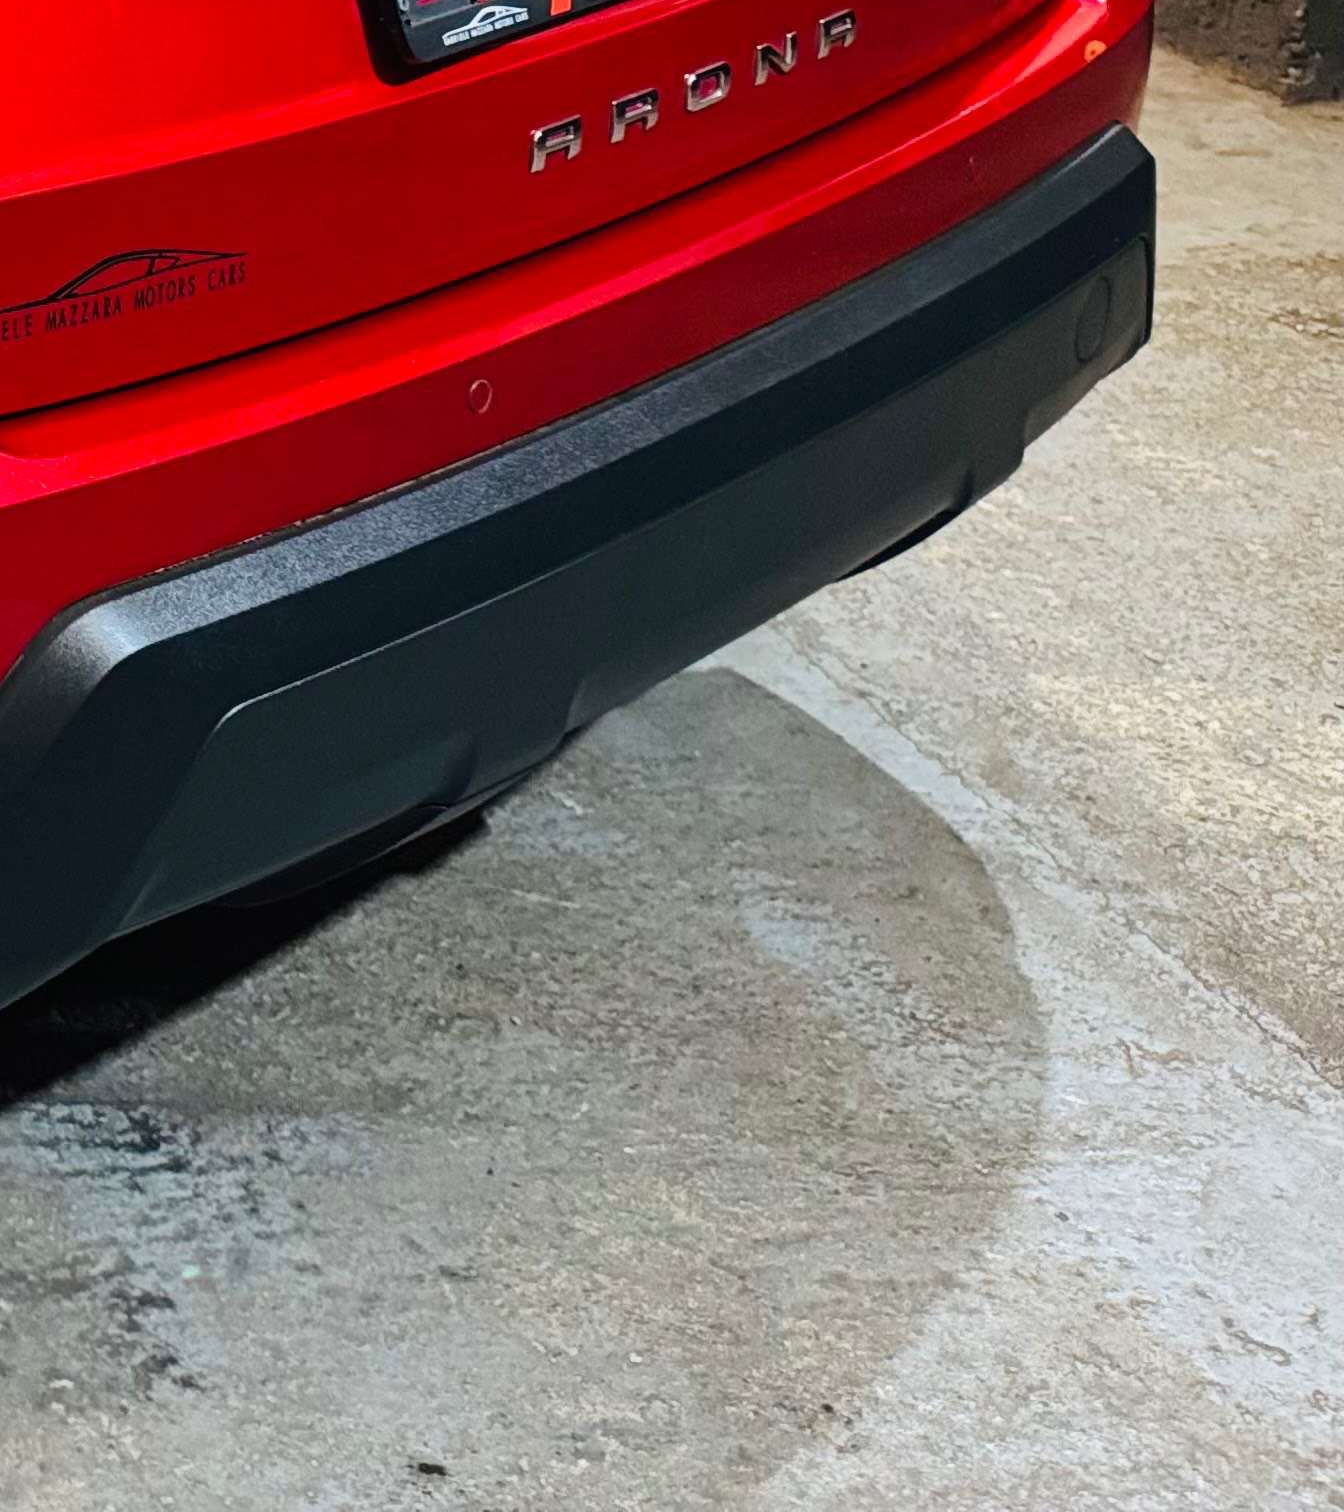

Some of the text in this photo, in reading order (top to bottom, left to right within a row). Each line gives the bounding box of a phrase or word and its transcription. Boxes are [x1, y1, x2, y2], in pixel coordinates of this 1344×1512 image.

[530, 8, 858, 173] ARONA
[45, 297, 122, 332] MAZZARA
[133, 275, 197, 311] MOTORS
[207, 261, 248, 292] CARS
